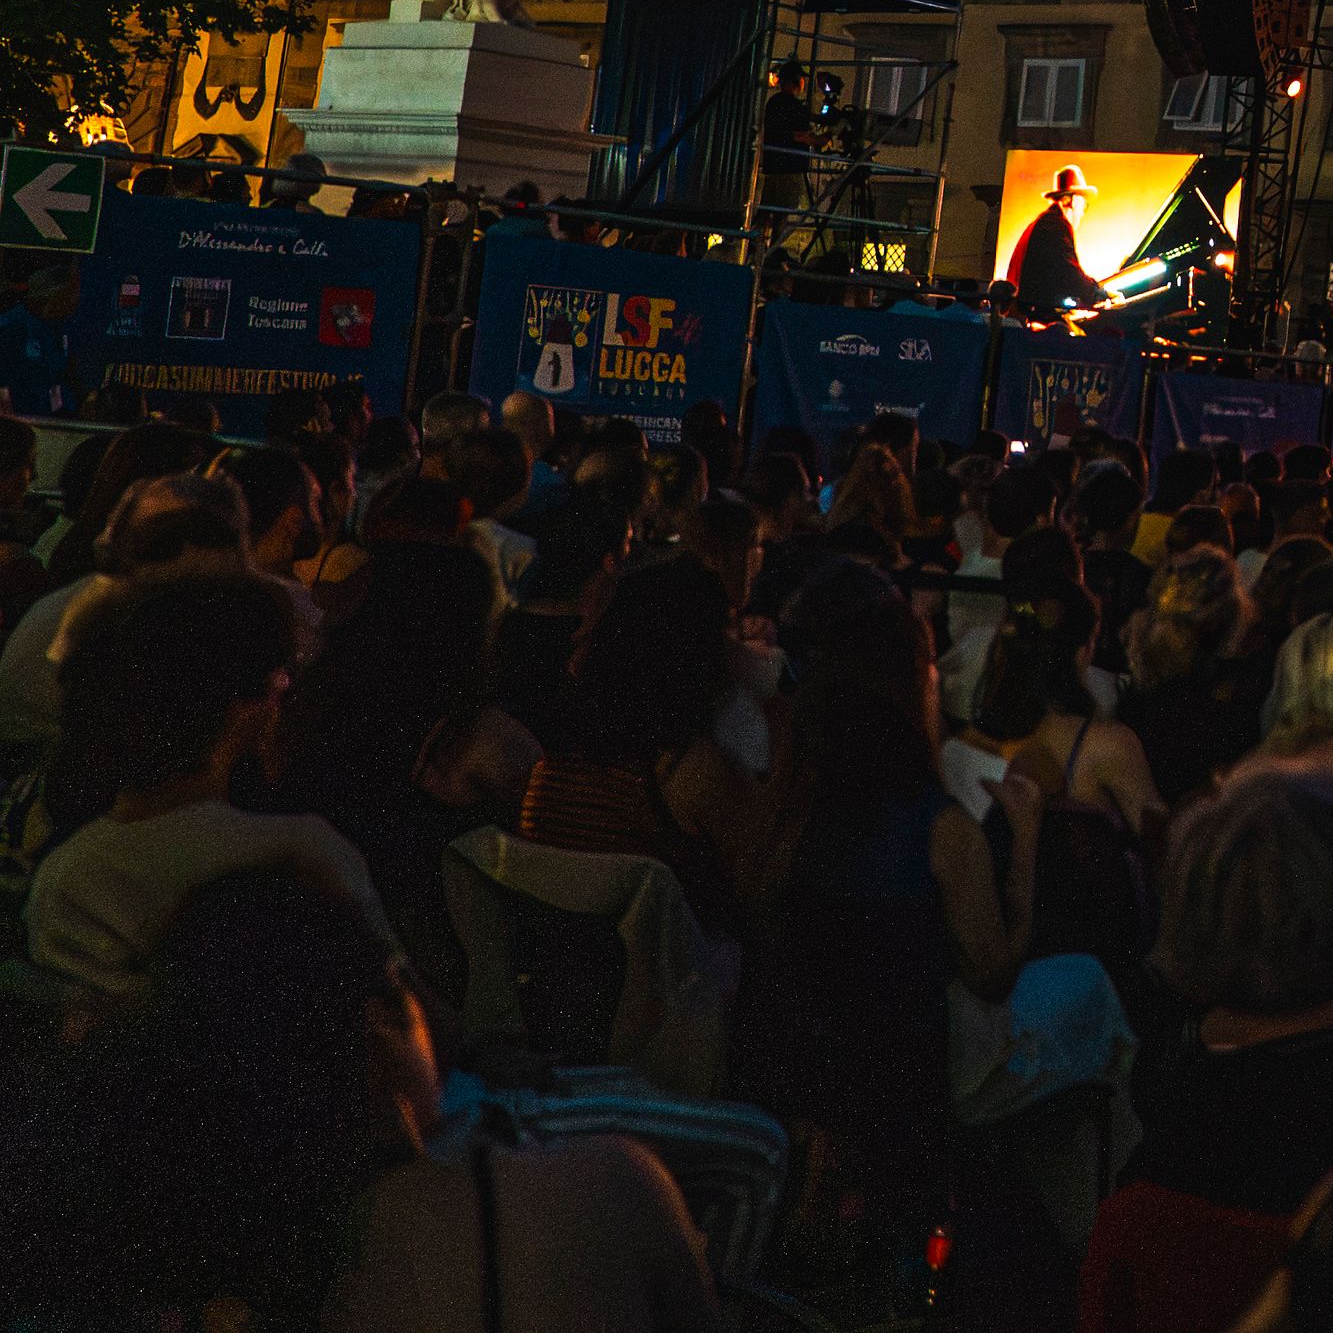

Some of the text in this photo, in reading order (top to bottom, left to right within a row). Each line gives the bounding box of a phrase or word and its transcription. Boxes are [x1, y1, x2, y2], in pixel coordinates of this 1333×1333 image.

[248, 296, 309, 313] Regione
[248, 313, 307, 330] Toscana
[602, 292, 677, 349] LSF
[599, 346, 688, 385] LUCCA
